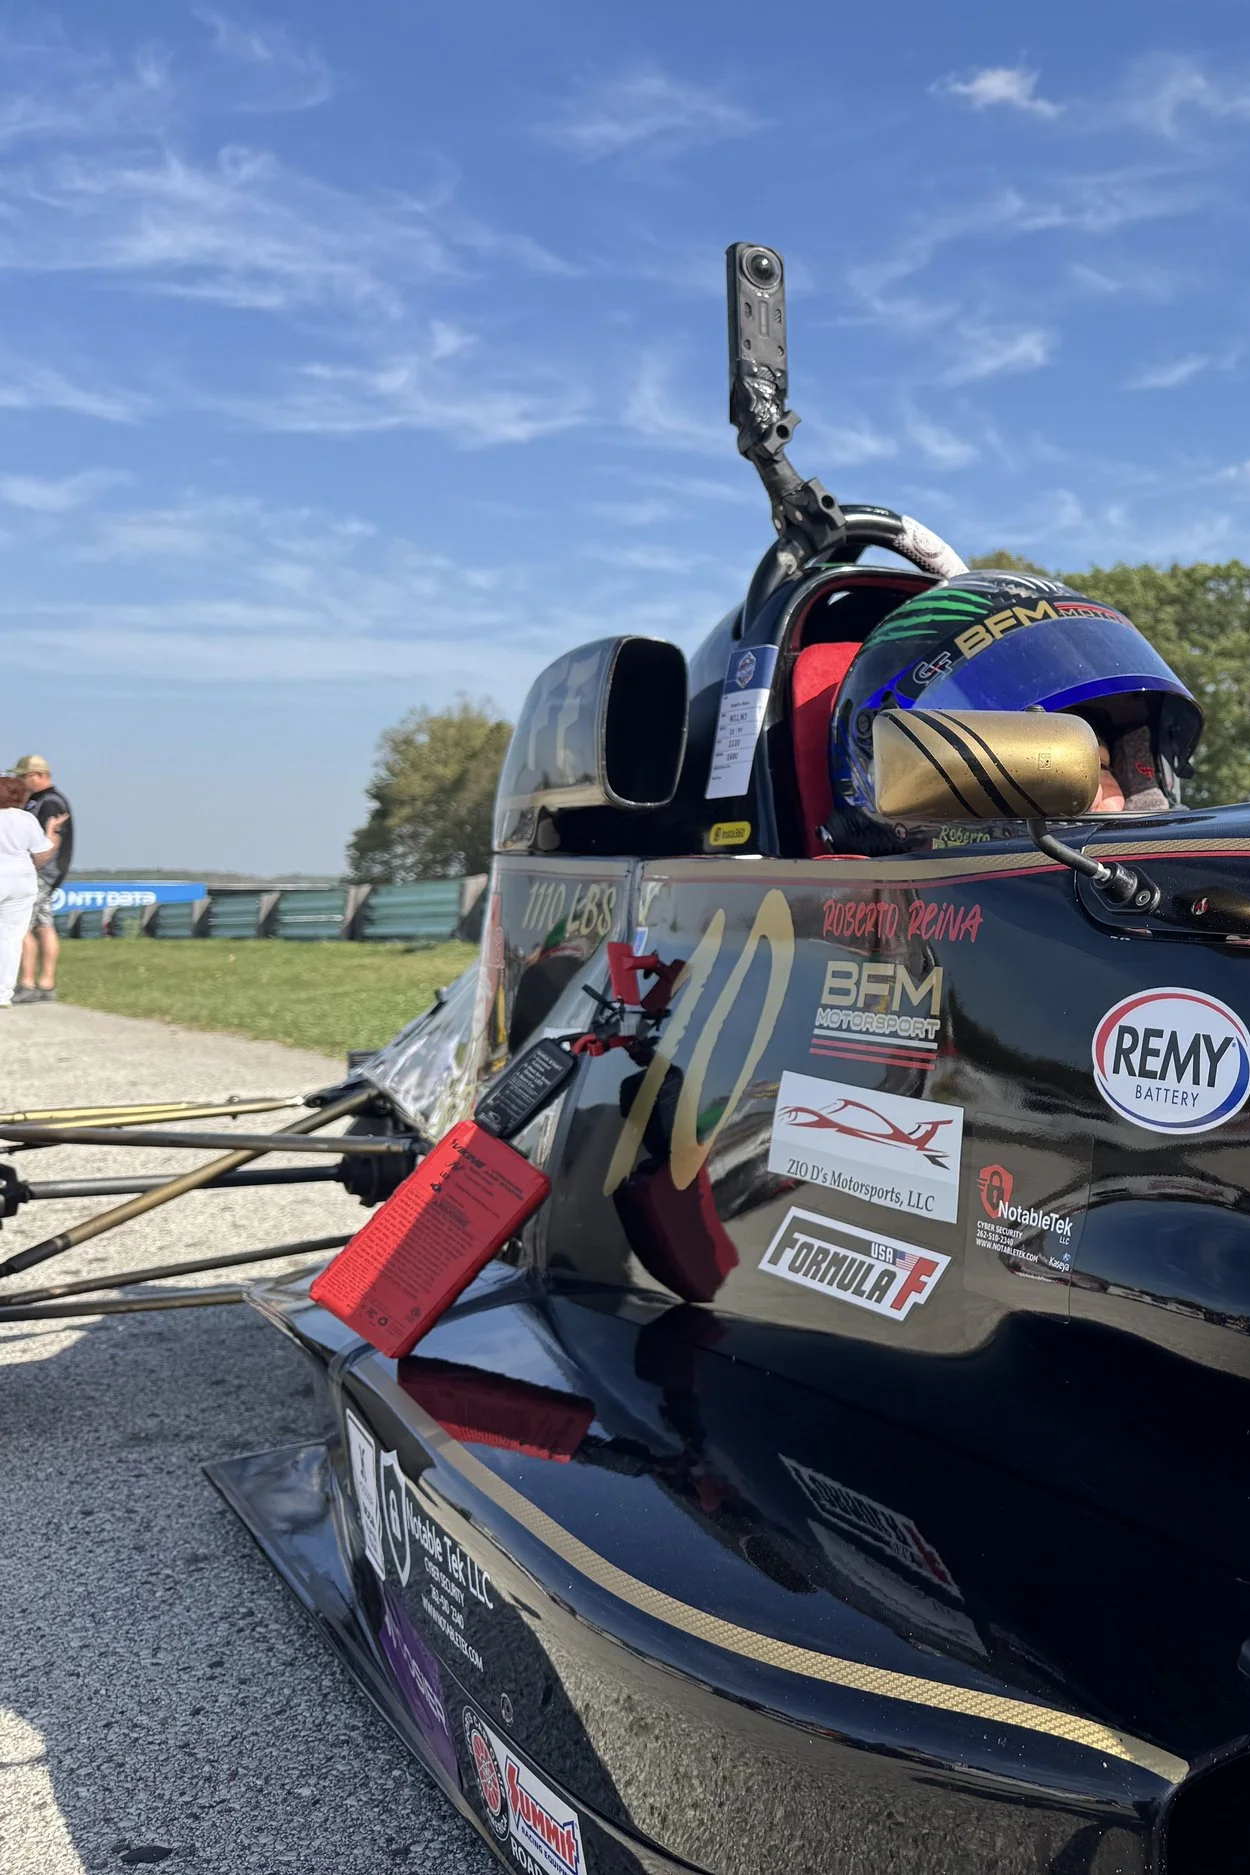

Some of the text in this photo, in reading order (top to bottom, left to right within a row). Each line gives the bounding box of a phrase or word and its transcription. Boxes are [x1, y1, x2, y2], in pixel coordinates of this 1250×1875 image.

[954, 600, 1122, 660] BFM MOTO
[67, 891, 105, 907] NTT
[522, 881, 626, 936] 1110 LBS
[821, 960, 943, 1016] BFM
[815, 1008, 941, 1039] MOTORSPORT
[603, 888, 795, 1197] 10
[1112, 1024, 1235, 1088] REMY
[1135, 1084, 1199, 1107] BATTERY
[787, 1158, 935, 1212] ZIO D's Motorsports, LLC
[977, 1220, 1023, 1240] CYBER SECURITY
[998, 1199, 1073, 1236] NotableTek
[975, 1238, 1038, 1263] WWW.NOTABLETEK.COM
[976, 1229, 1014, 1246] 262-510-2340
[1059, 1236, 1070, 1245] LLC
[767, 1215, 940, 1311] FORMULA F
[871, 1242, 894, 1265] USA
[1048, 1256, 1070, 1272] Kaseya
[405, 1498, 494, 1610] Notable Tek LLC
[521, 1826, 543, 1854] RACING
